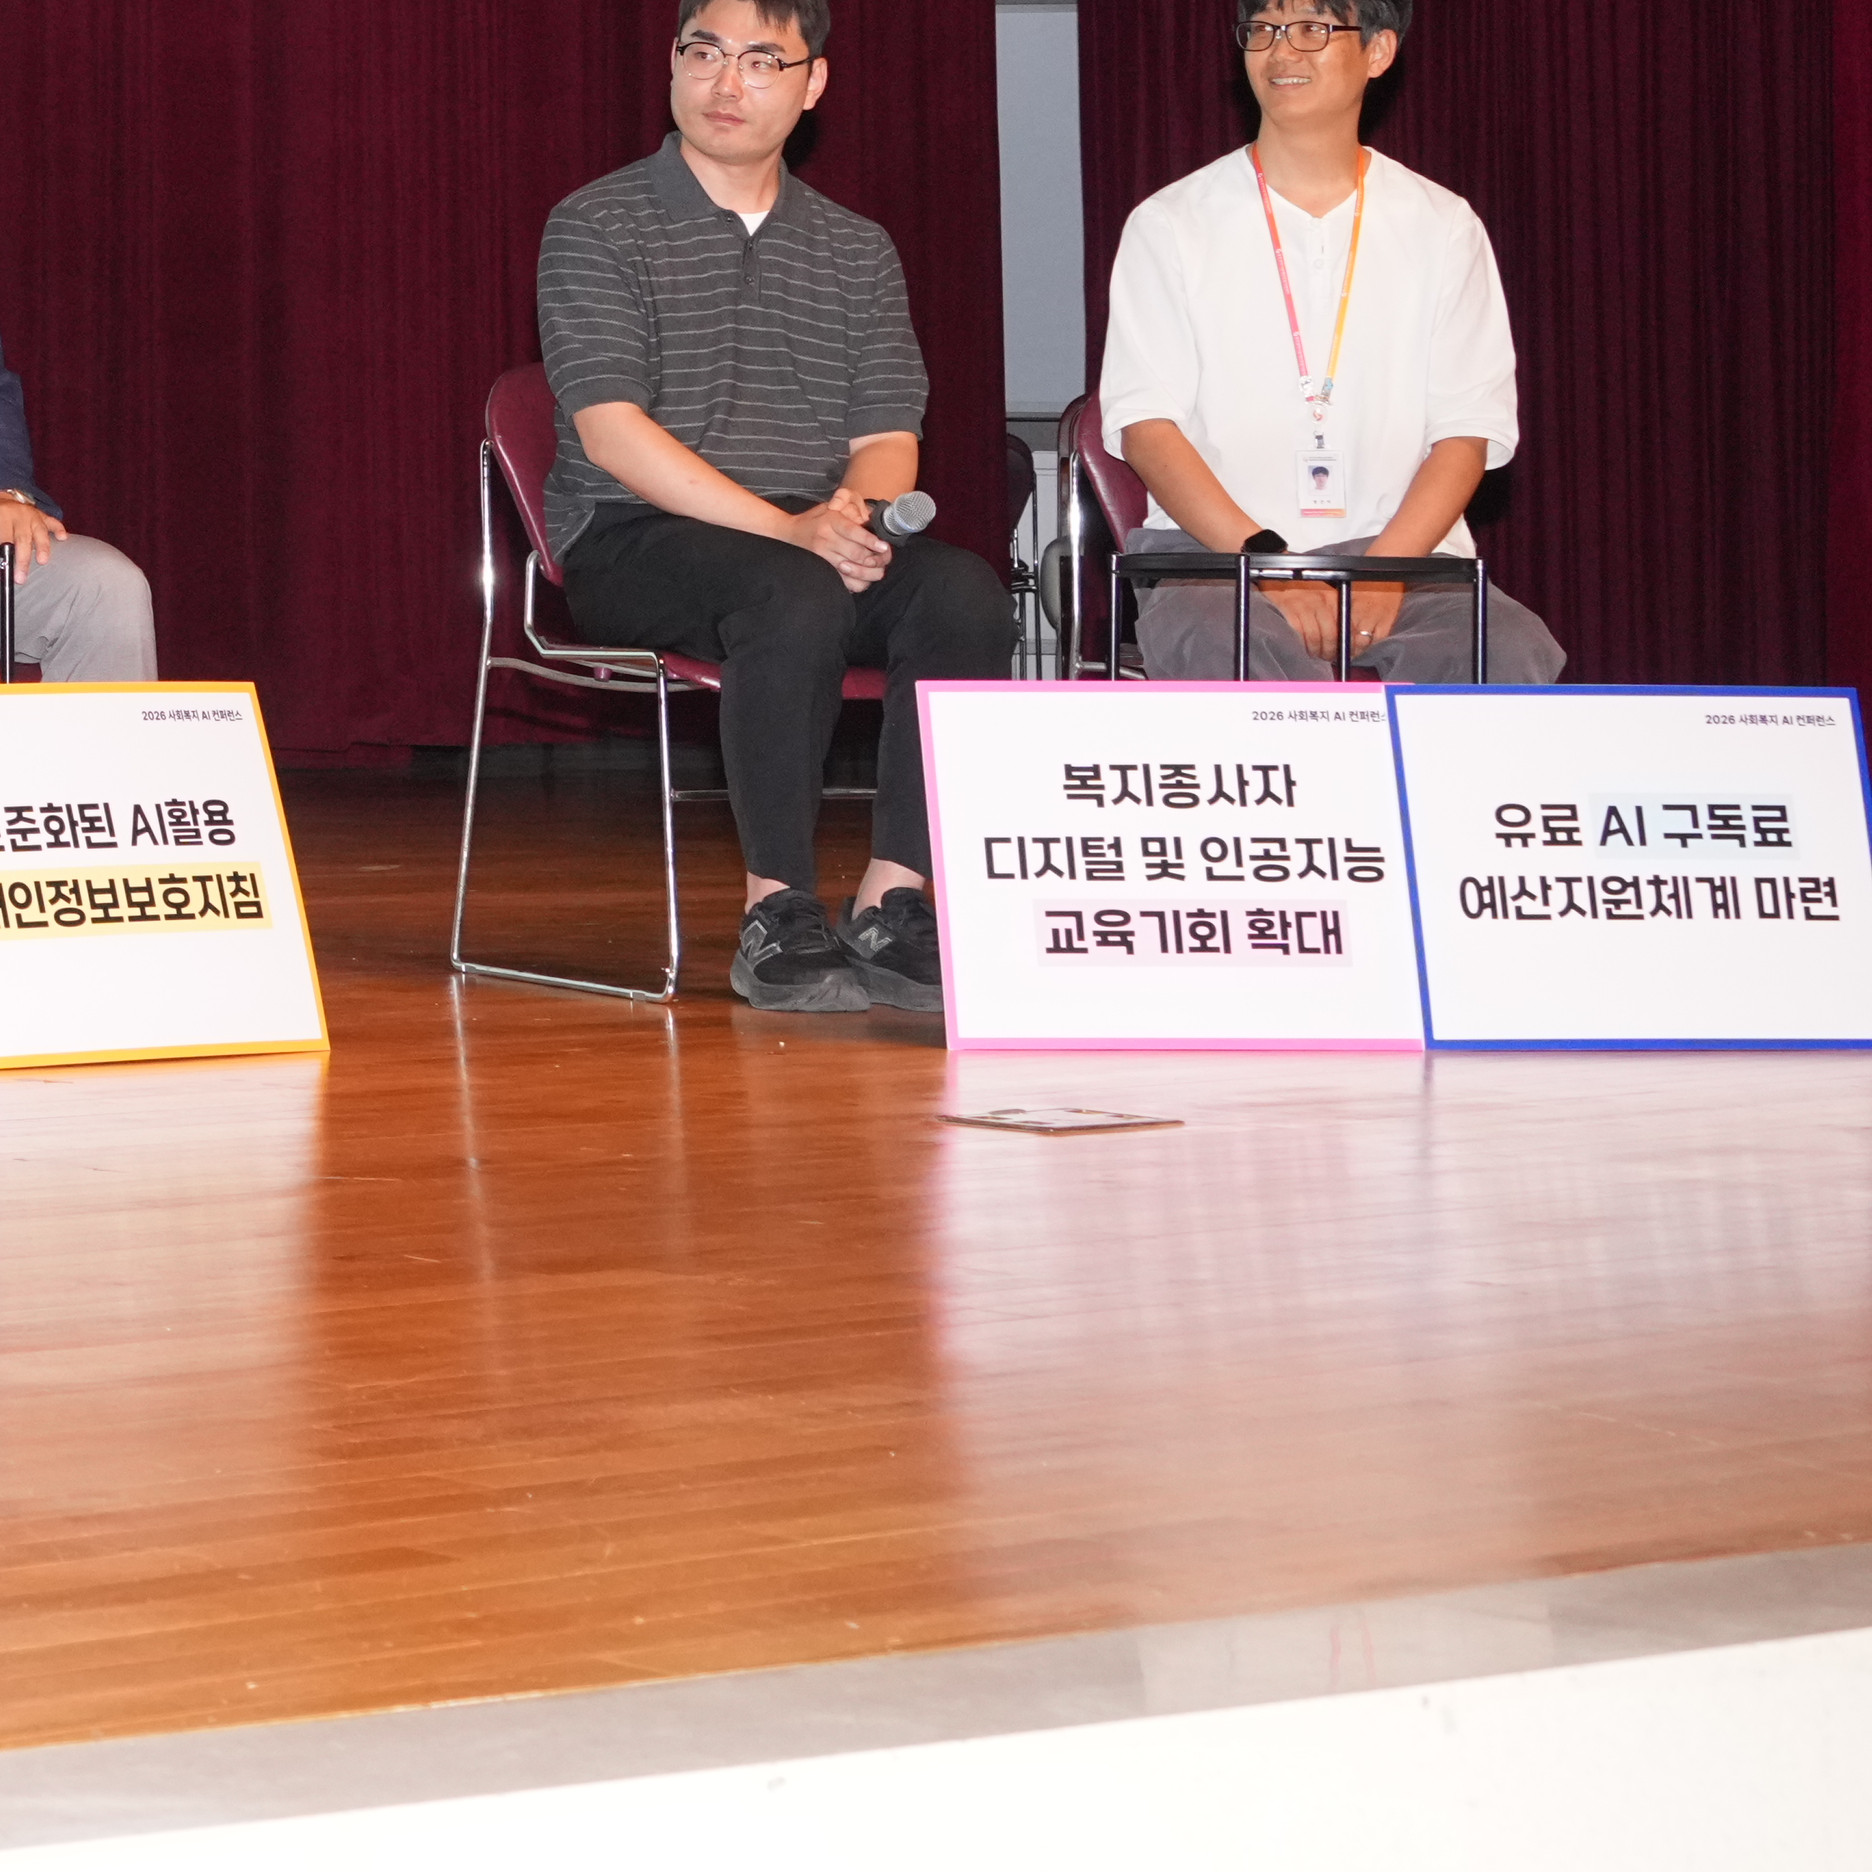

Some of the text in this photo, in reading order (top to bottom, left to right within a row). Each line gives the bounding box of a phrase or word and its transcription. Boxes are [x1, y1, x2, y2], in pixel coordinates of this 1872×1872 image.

[142, 709, 243, 722] 2026 사회복지 AI 컨퍼런스
[1252, 711, 1284, 721] 2026
[1288, 710, 1330, 722] 사회복지
[1334, 711, 1346, 721] AI
[1705, 714, 1837, 727] 2026 사회복지 AI 컨퍼런스
[1062, 762, 1297, 811] 복지종사자
[131, 797, 236, 847] AI활용
[1493, 802, 1793, 850] 유료 AI 구독료
[984, 835, 1387, 883] 디지털 및 인공지능
[1459, 875, 1841, 923] 예산지원체계 마련
[1245, 908, 1343, 957] 확대
